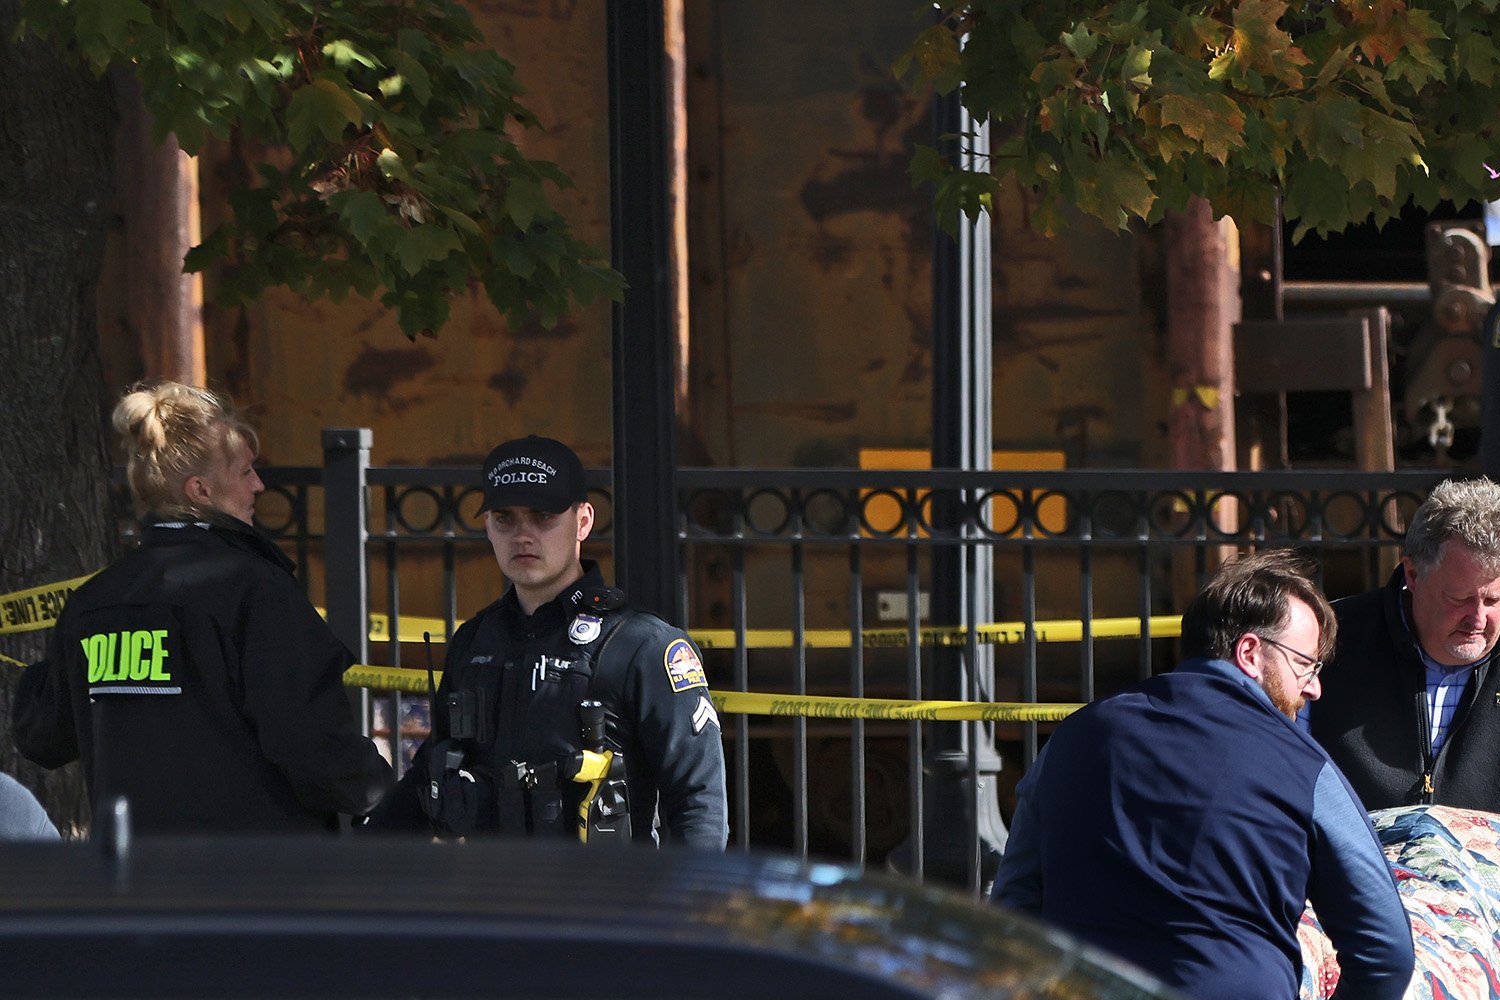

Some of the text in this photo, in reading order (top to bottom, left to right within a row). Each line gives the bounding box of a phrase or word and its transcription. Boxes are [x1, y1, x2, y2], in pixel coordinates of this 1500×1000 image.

[532, 459, 557, 477] BEACH
[493, 471, 548, 488] POLICE
[571, 589, 584, 605] PD
